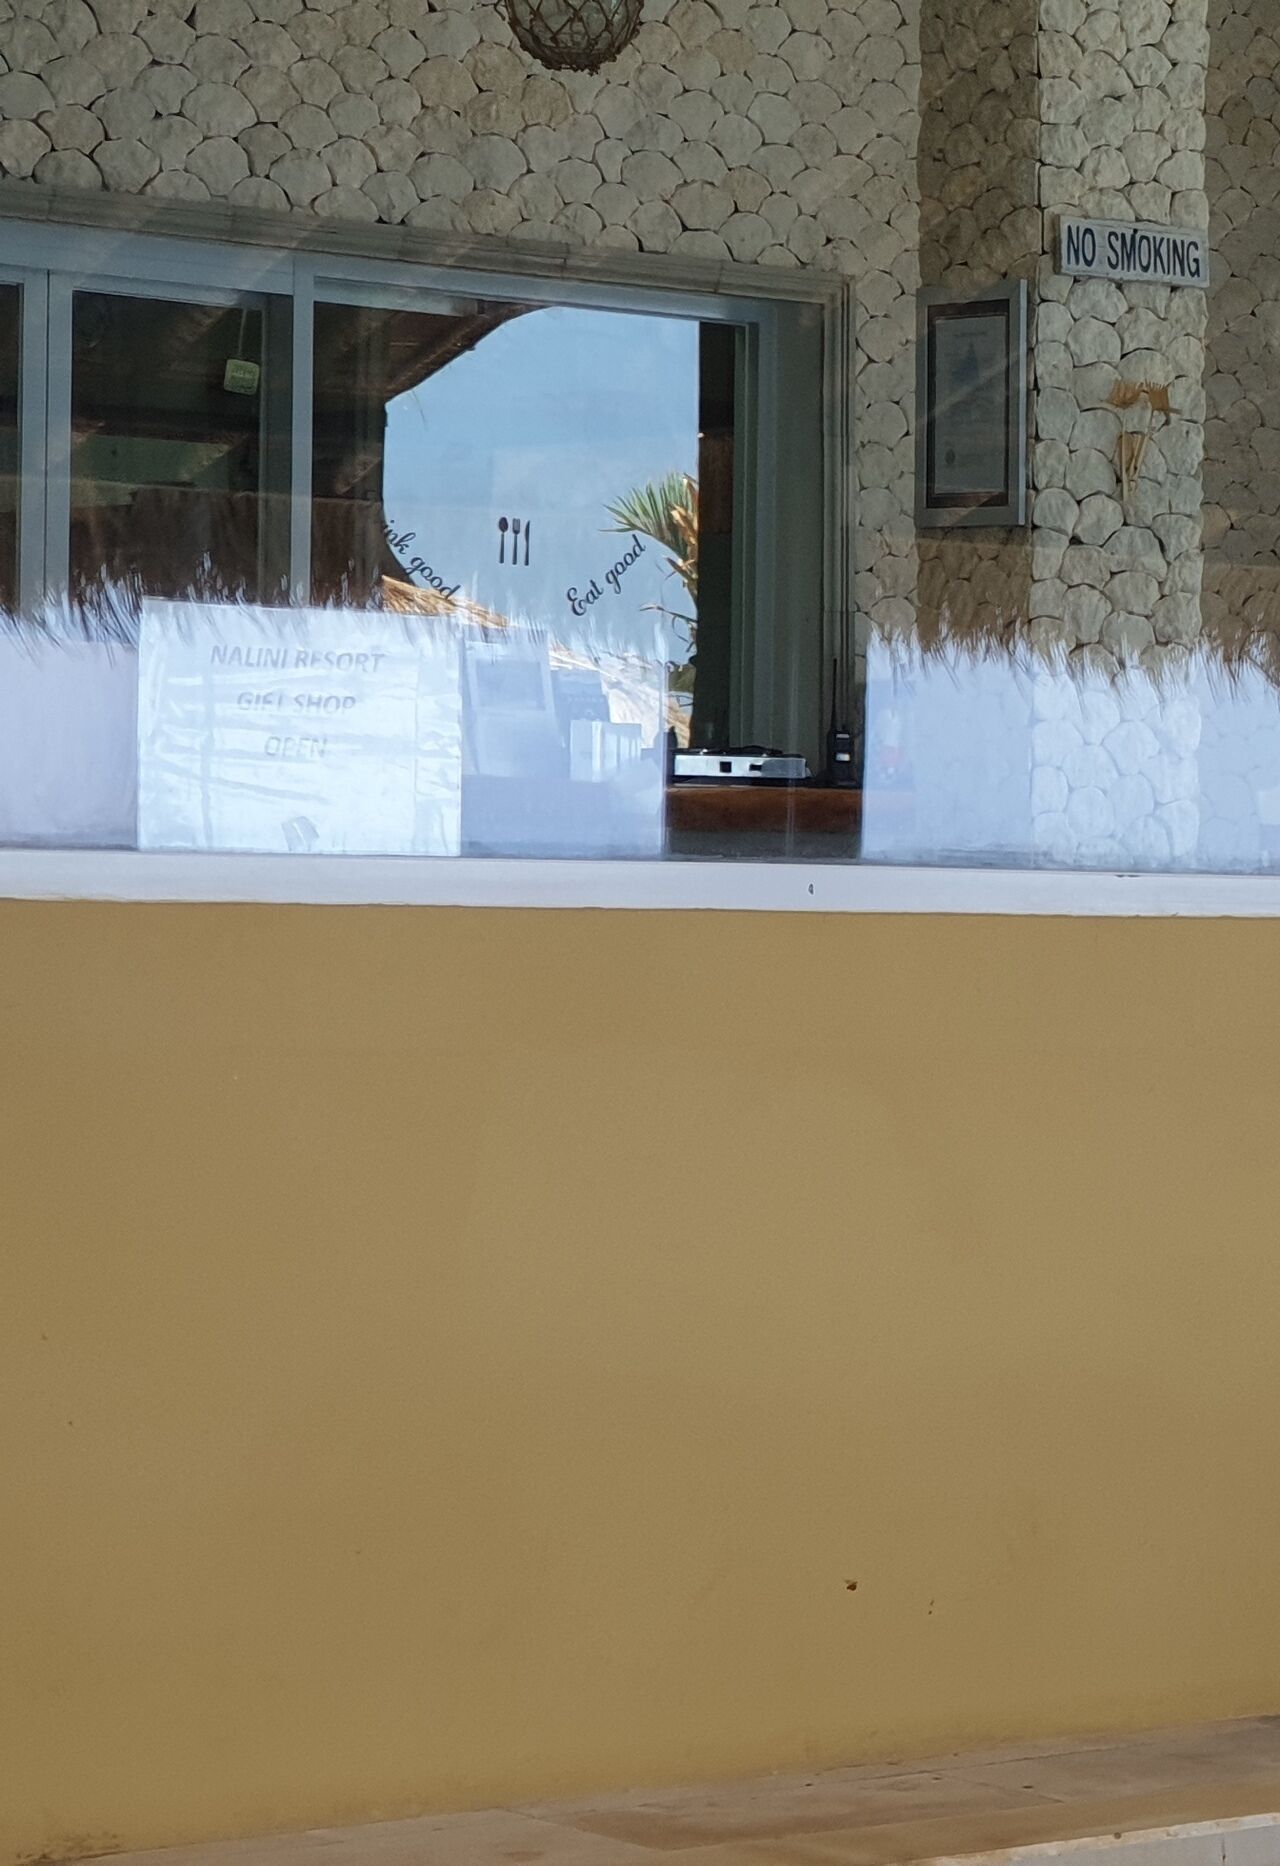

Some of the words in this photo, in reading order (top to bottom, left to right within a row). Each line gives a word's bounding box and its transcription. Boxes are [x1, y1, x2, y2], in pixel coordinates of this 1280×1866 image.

[1066, 225, 1097, 267] NO
[1107, 230, 1201, 278] SMOKING
[566, 578, 605, 617] Eat
[605, 533, 647, 595] good
[211, 645, 289, 669] NALINI
[294, 693, 357, 714] SHOP
